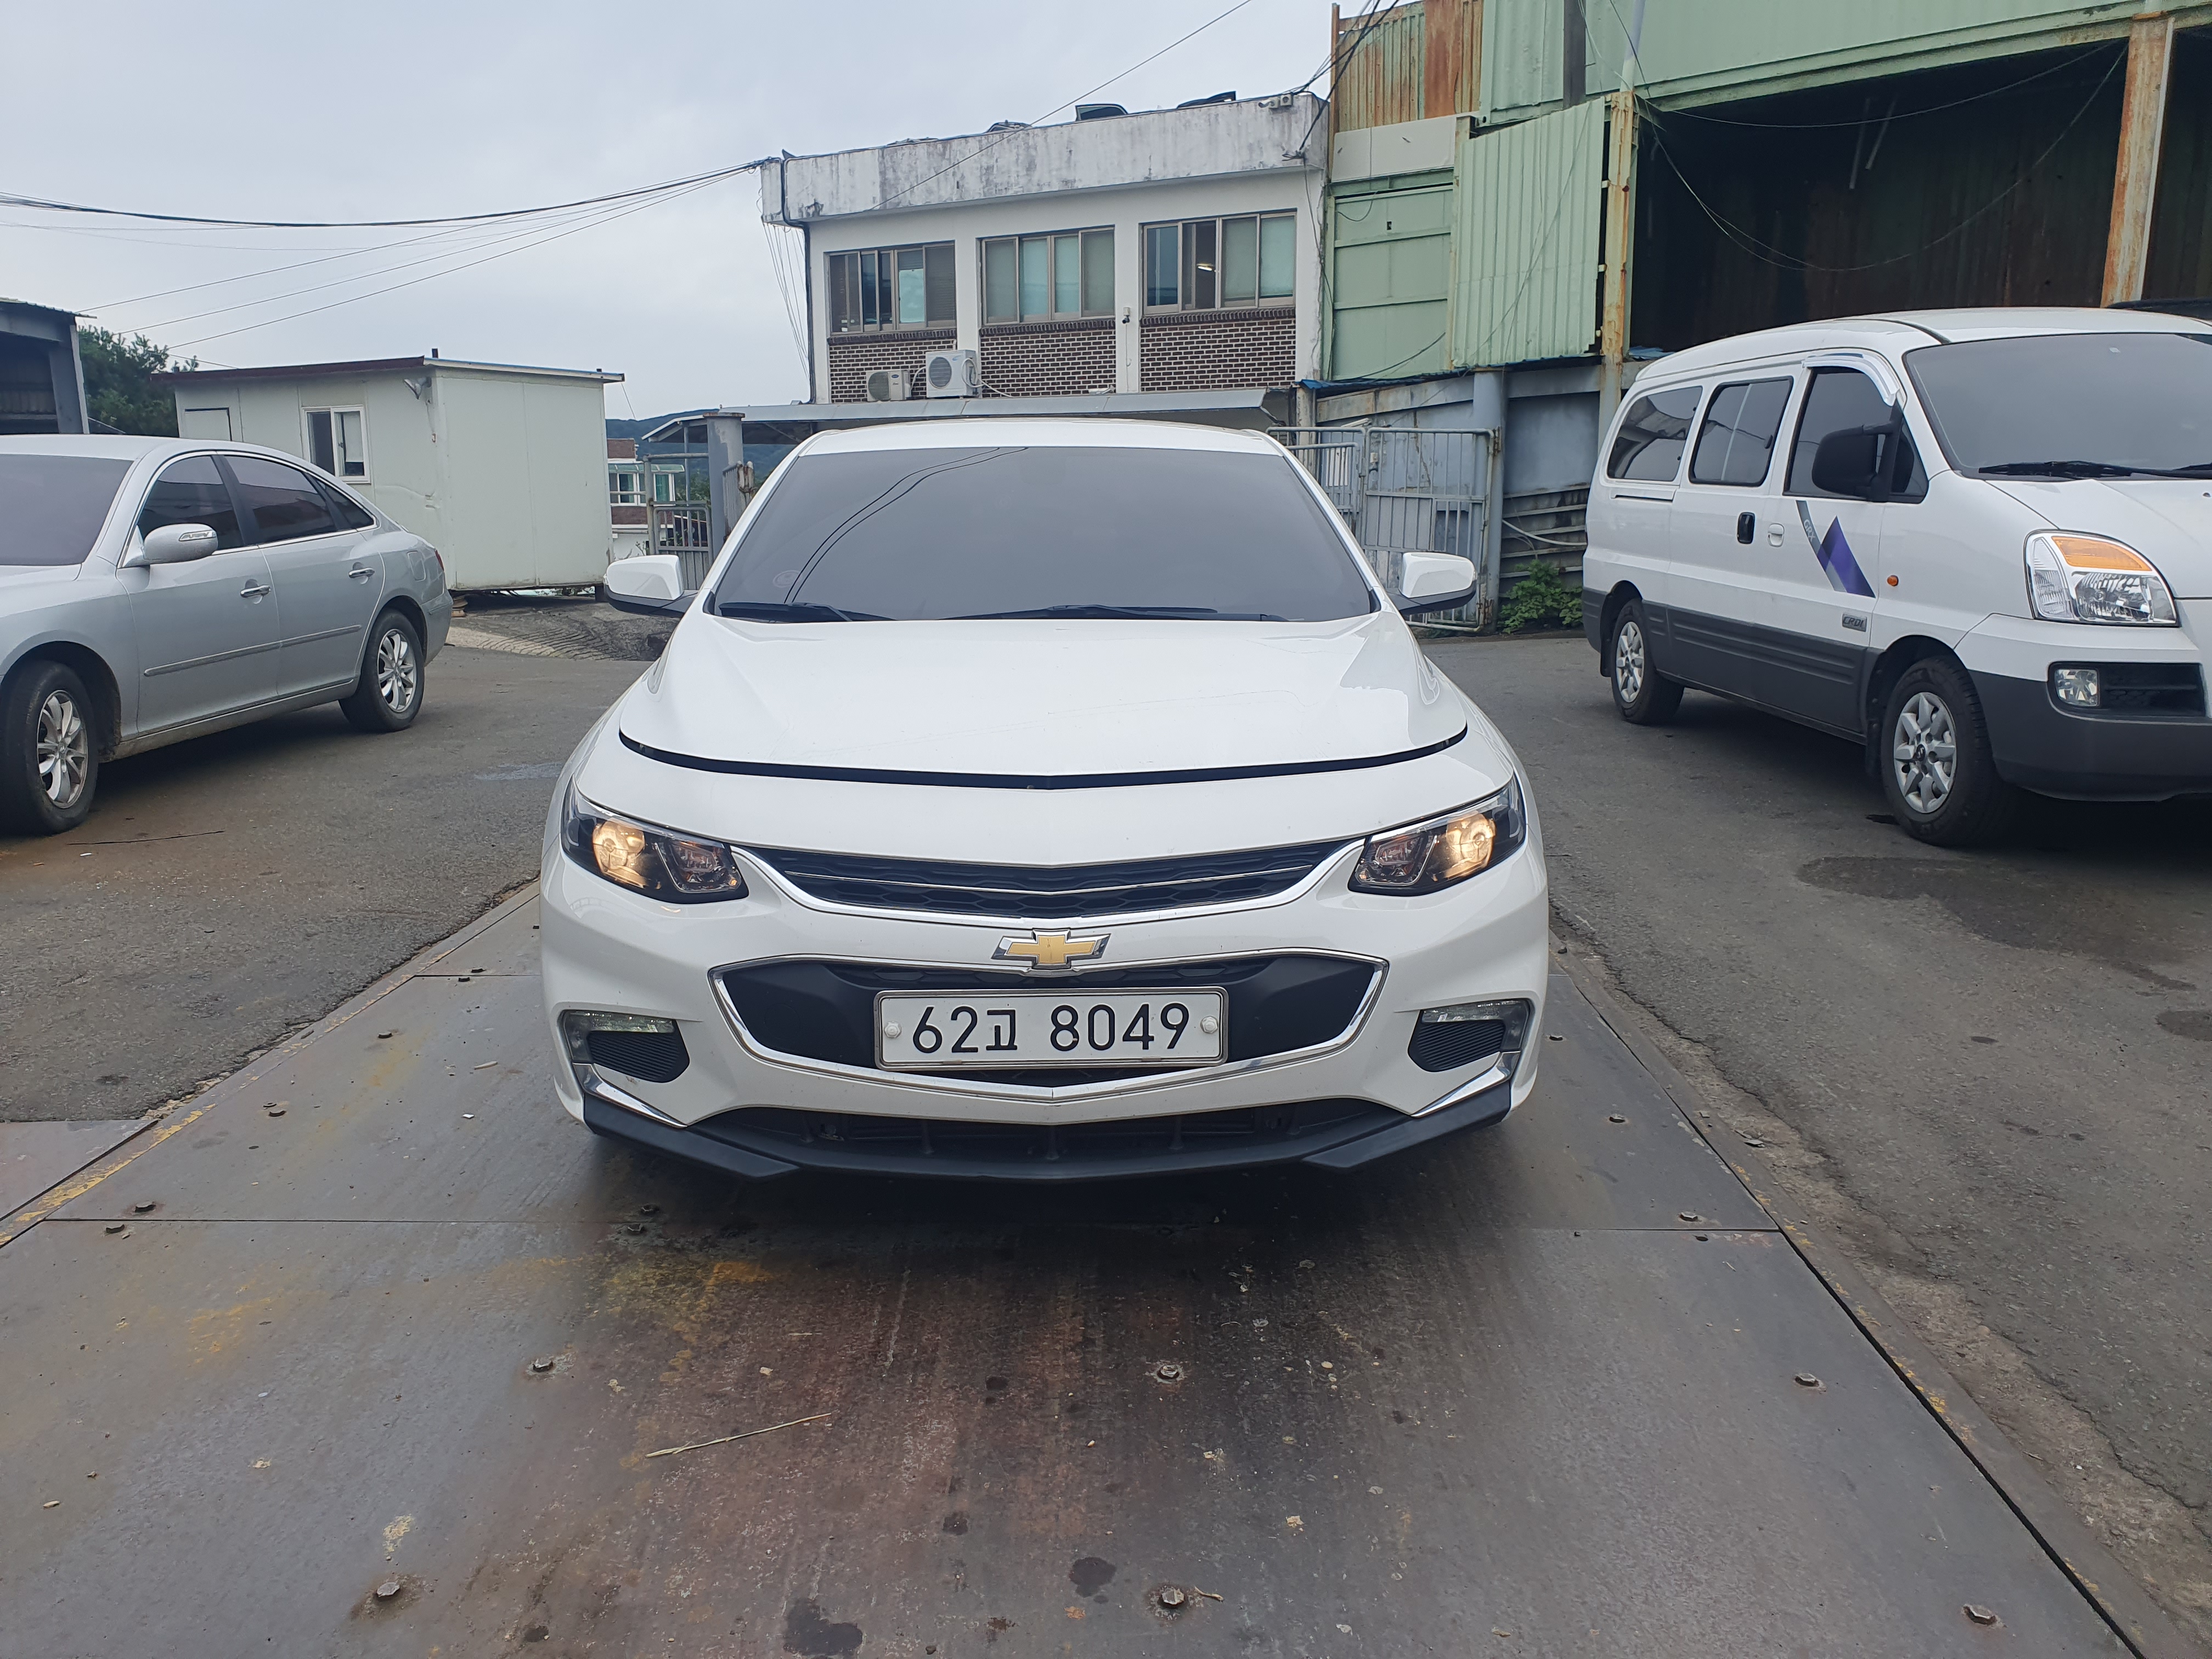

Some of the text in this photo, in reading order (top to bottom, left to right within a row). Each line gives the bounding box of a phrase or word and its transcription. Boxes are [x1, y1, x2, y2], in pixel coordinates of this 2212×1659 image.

[1804, 519, 1815, 542] GRX
[912, 1002, 1189, 1053] 62고 8049
